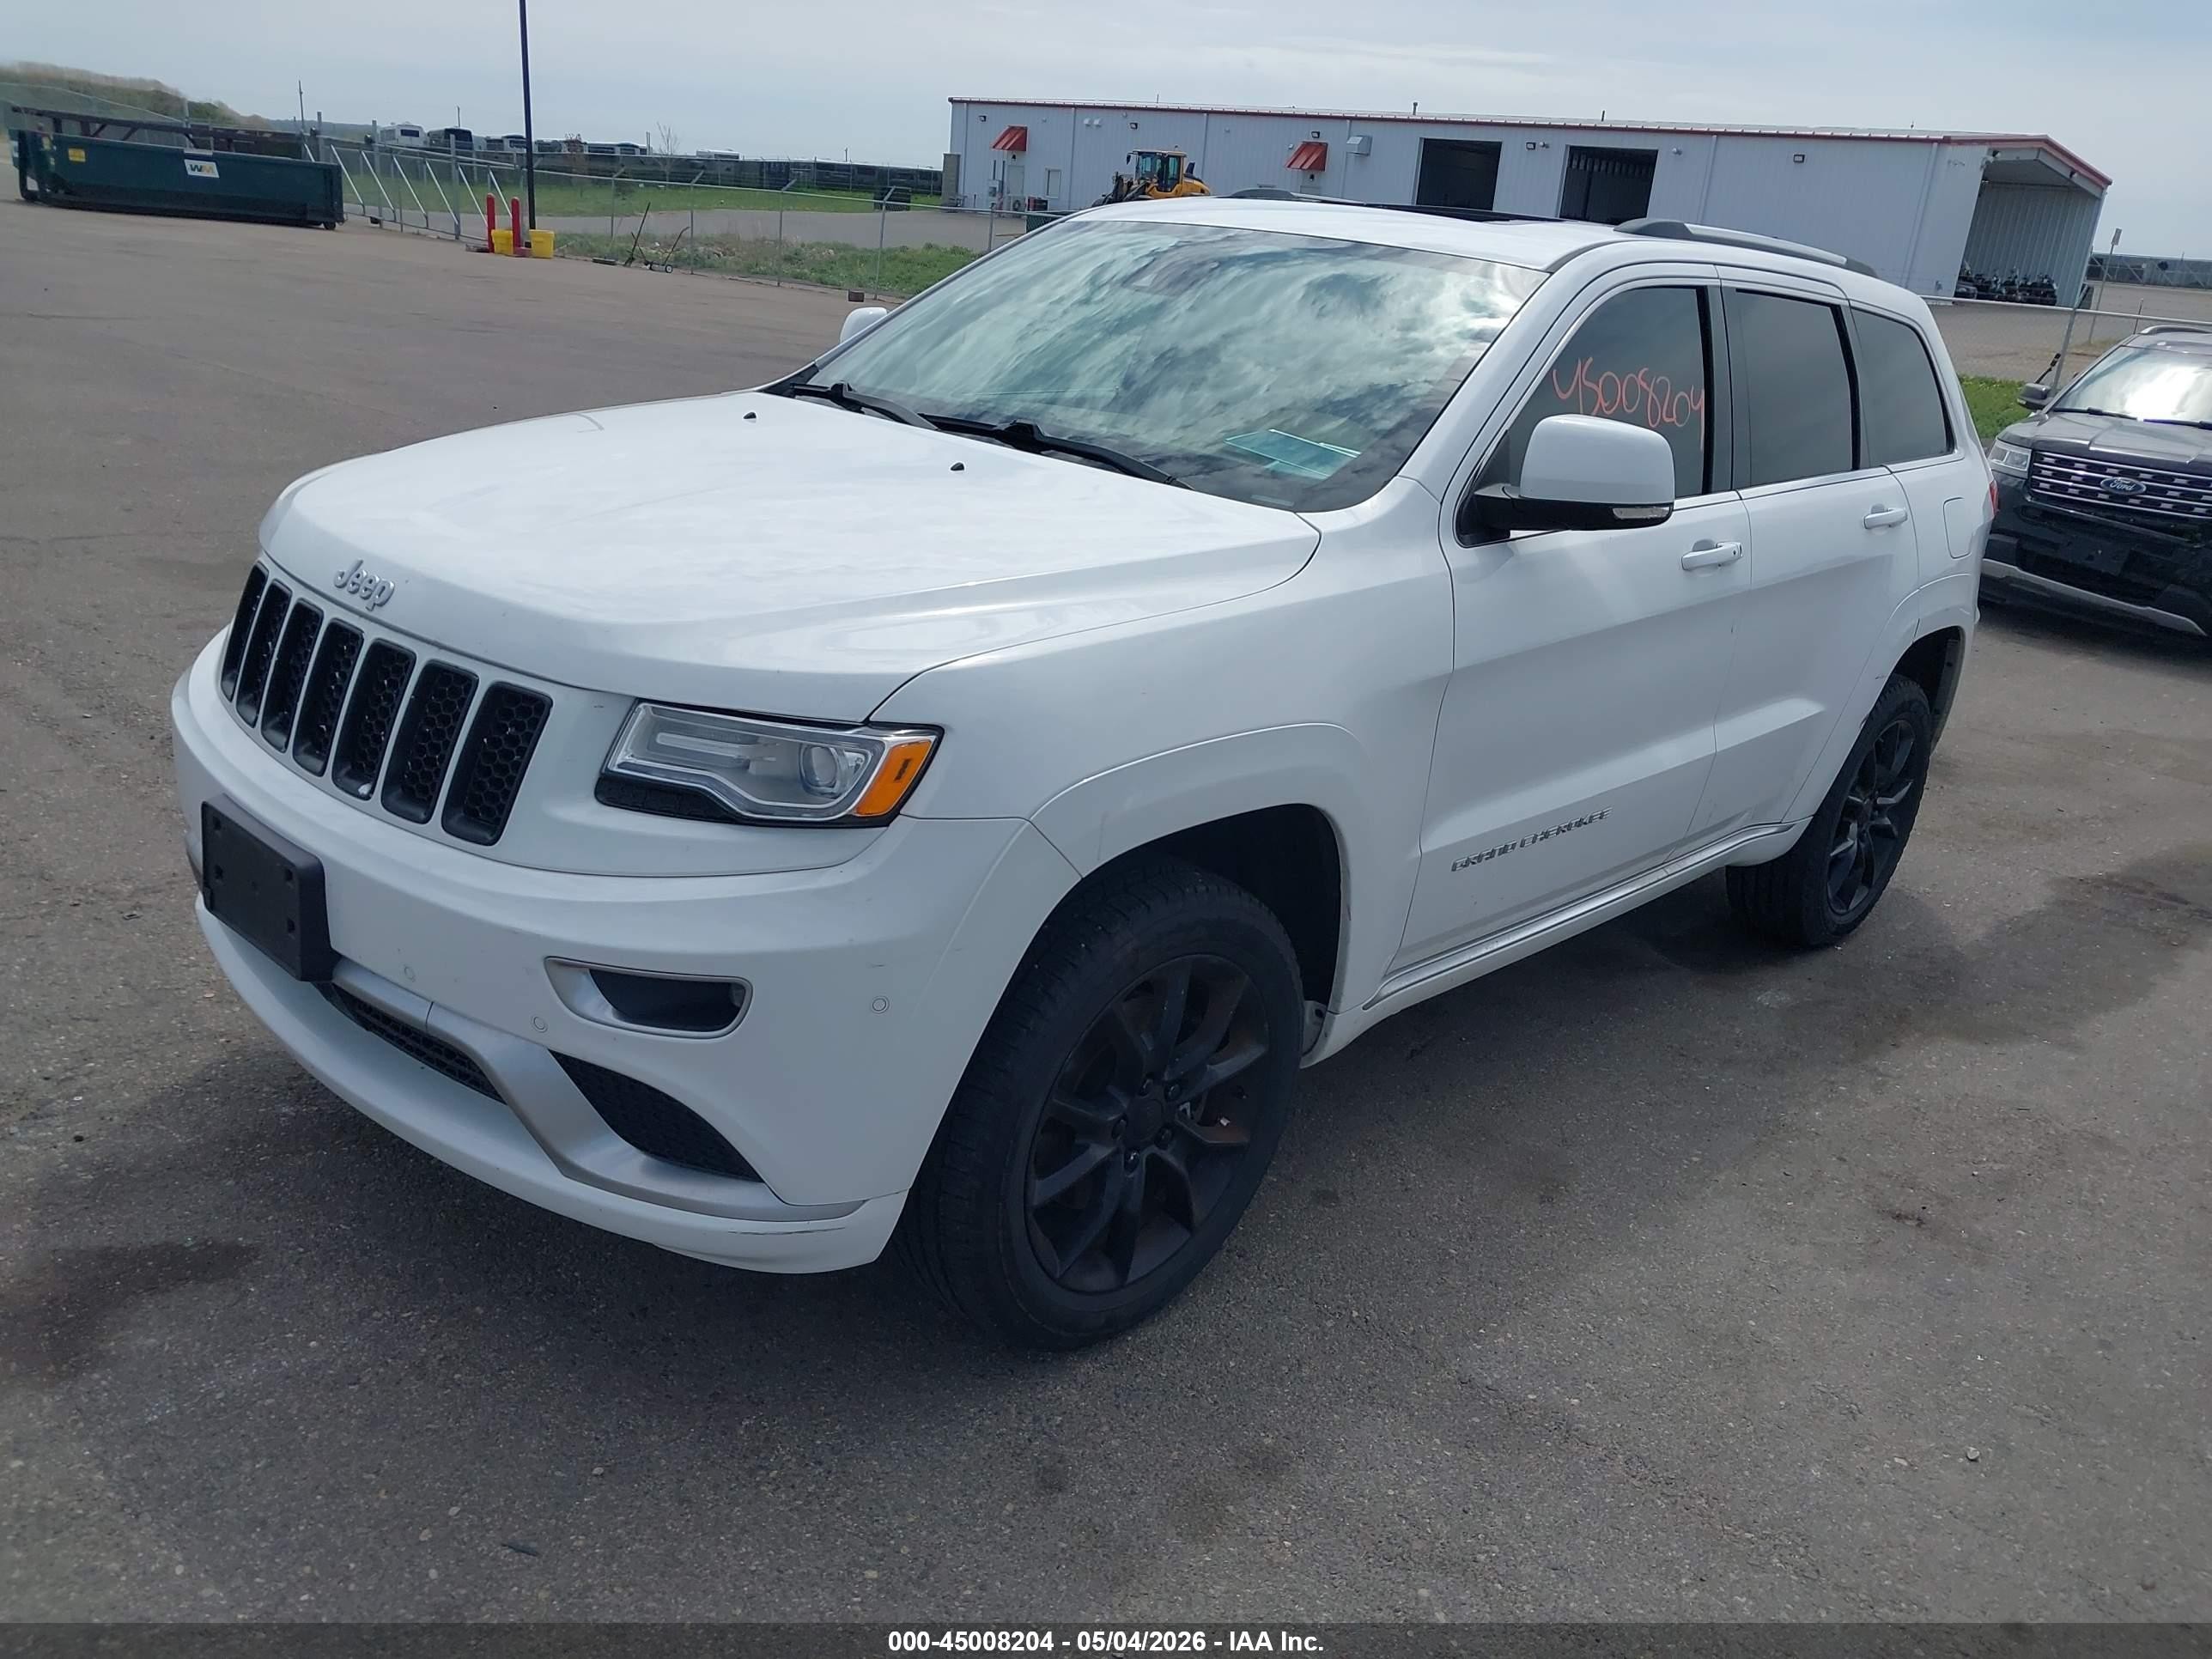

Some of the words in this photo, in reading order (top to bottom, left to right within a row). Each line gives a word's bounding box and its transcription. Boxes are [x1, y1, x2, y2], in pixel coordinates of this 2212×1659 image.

[1552, 356, 1705, 453] 45008204
[2110, 479, 2136, 491] Ford
[334, 558, 395, 612] Jeep
[1451, 840, 1517, 872] GRAND
[1520, 806, 1613, 848] CHEROKEE
